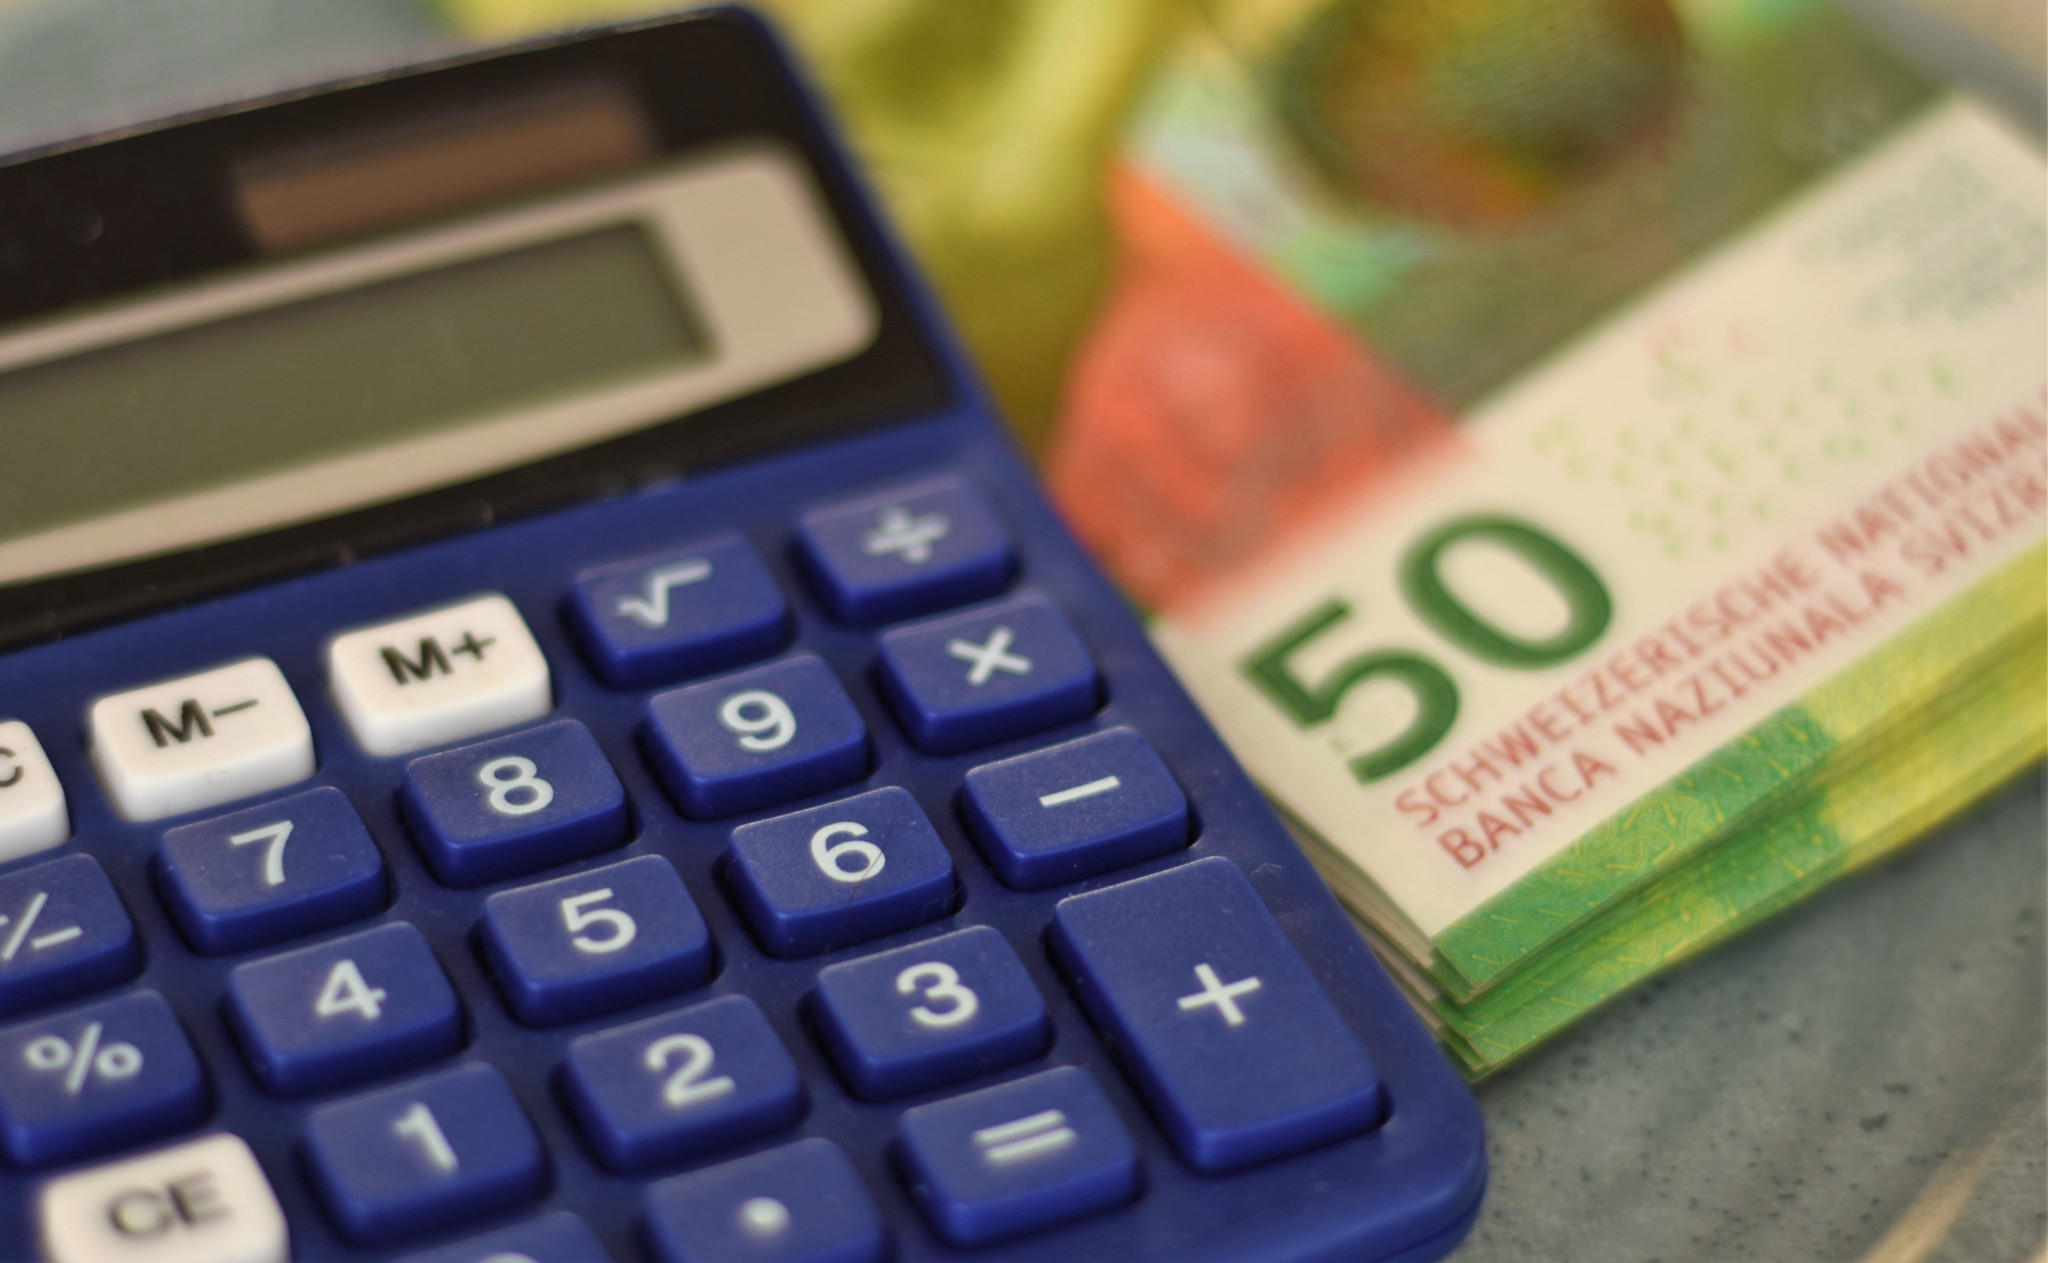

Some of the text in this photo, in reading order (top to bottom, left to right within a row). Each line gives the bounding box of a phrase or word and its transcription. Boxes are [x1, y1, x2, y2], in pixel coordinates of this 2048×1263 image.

[1395, 380, 2048, 829] SCHWEIZERISCHE NATIONAL
[380, 631, 495, 684] M+
[1240, 512, 1614, 784] 50
[1437, 455, 2048, 871] BANCA NAZIUNALA SVIZR
[720, 690, 797, 750] 9
[479, 756, 554, 815] 8
[230, 820, 294, 886] 7
[810, 821, 886, 883] 6
[561, 888, 637, 953] 5
[315, 960, 387, 1020] 4
[896, 962, 979, 1027] 3
[24, 1022, 144, 1094] %
[644, 1033, 736, 1106] 2
[393, 1102, 458, 1172] 1
[105, 1169, 231, 1240] CE
